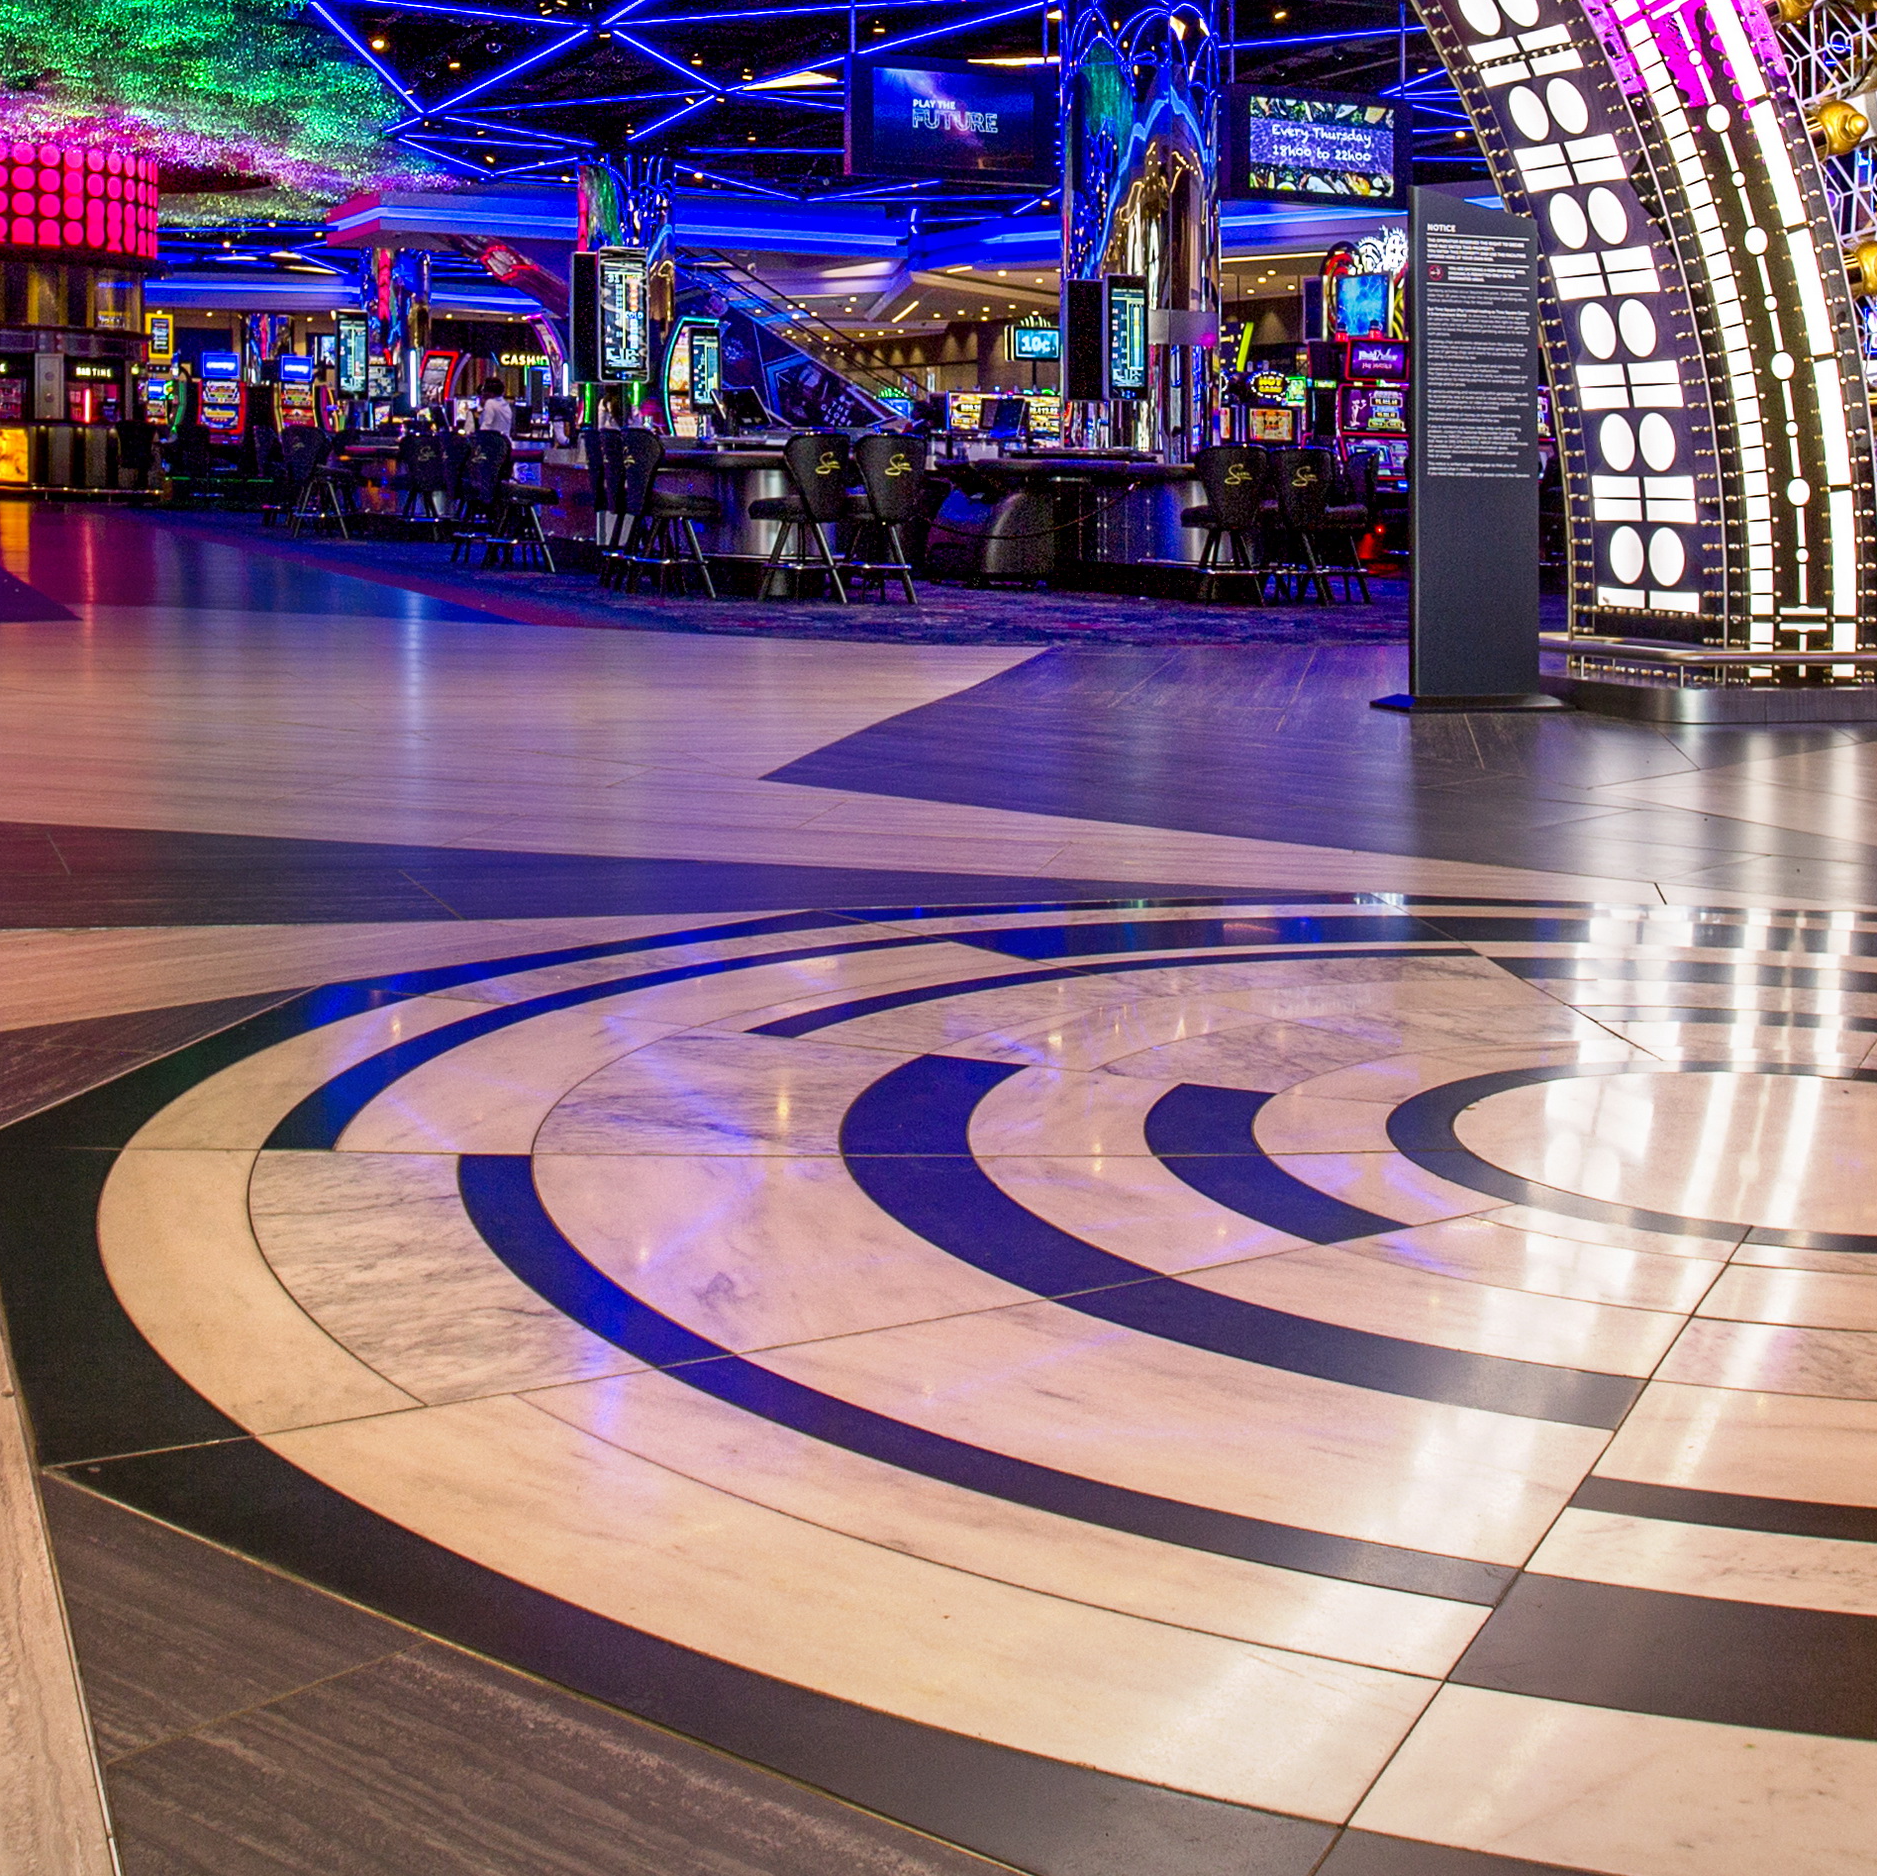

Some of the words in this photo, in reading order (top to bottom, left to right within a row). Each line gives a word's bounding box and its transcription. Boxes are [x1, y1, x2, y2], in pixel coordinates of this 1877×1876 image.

[913, 99, 935, 108] PLAY
[937, 100, 956, 110] THE
[912, 108, 999, 134] FUTURE
[1272, 124, 1308, 144] Every
[1312, 127, 1372, 150] Thursday
[1272, 144, 1311, 158] 18h00
[1316, 147, 1331, 161] to
[1334, 150, 1372, 163] 22h00
[1427, 223, 1456, 233] NOTICE
